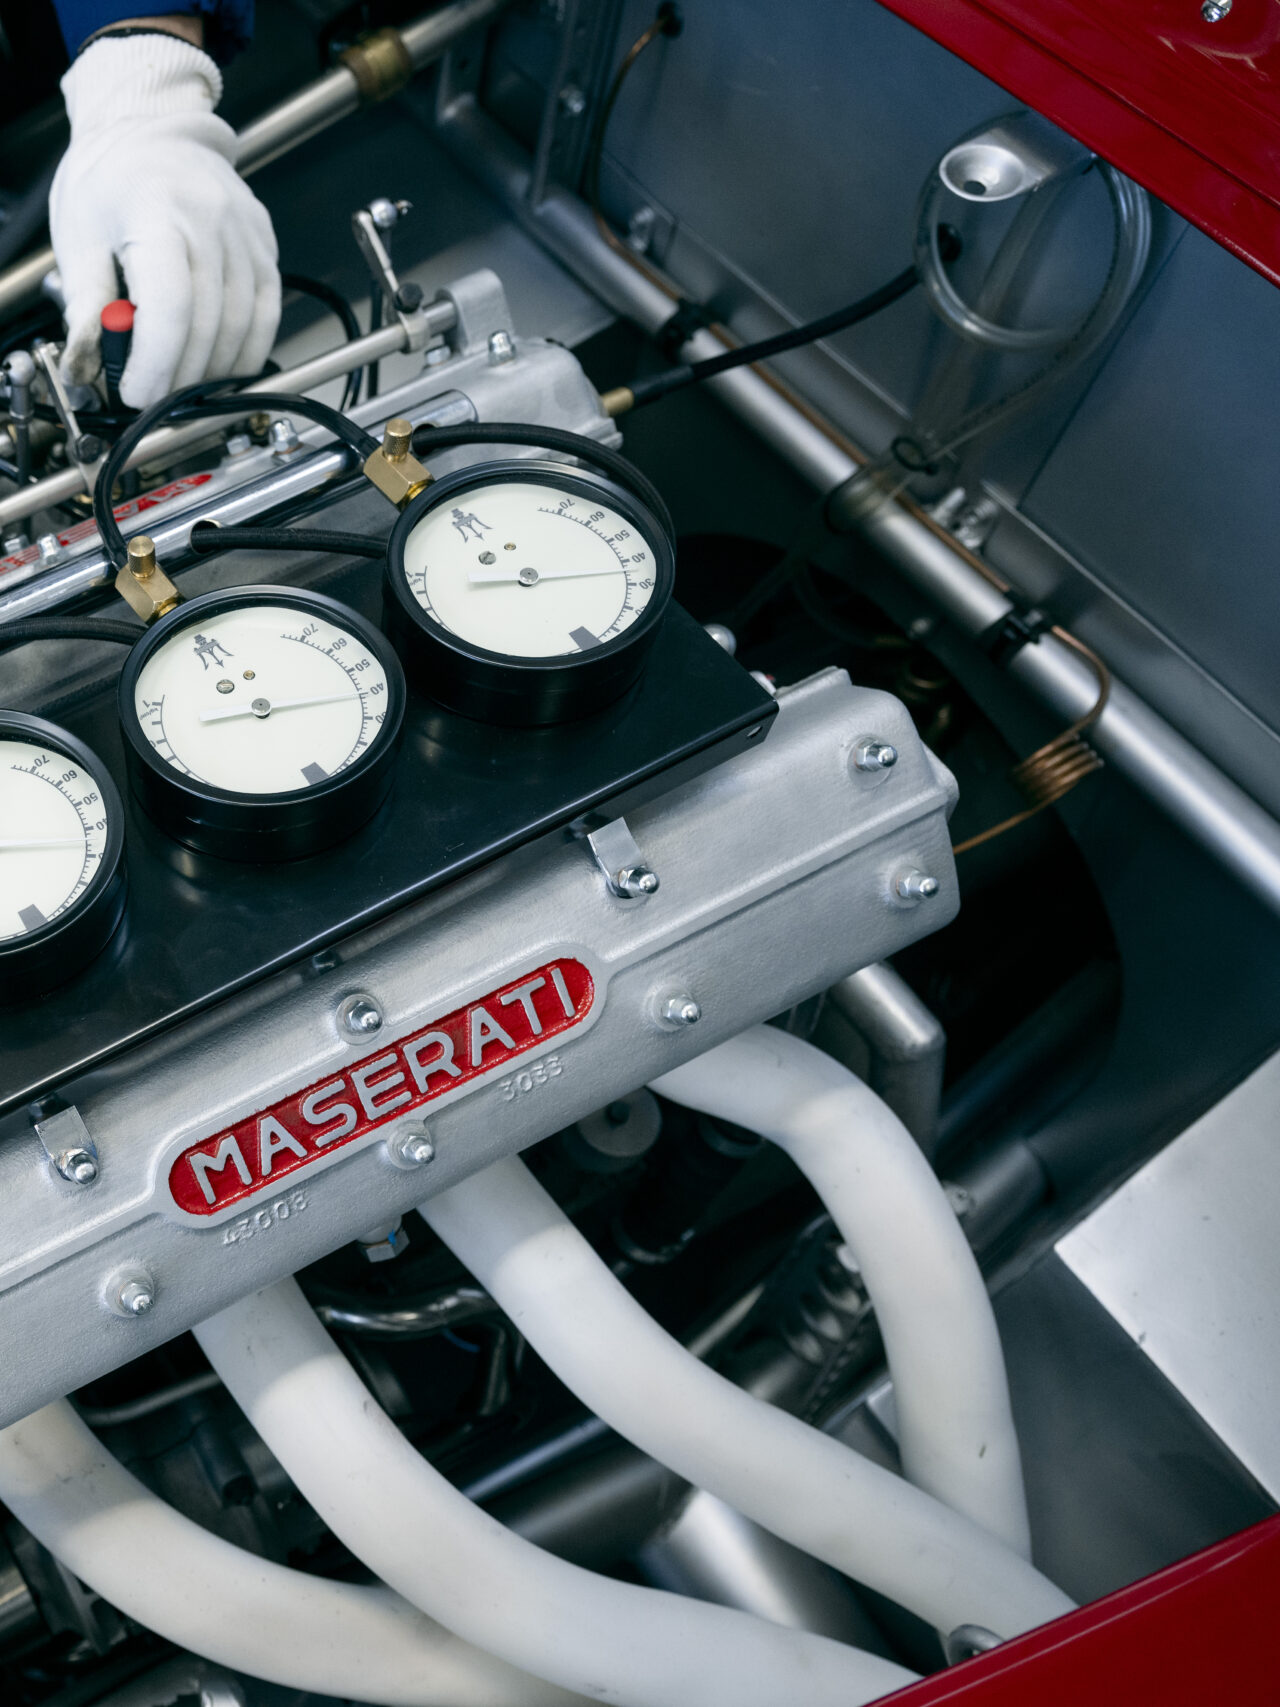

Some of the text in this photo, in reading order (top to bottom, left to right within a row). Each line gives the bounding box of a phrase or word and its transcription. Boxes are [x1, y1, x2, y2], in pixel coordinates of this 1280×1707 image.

[559, 499, 575, 511] 70
[589, 510, 606, 523] 60
[614, 529, 631, 542] 50
[631, 552, 646, 564] 40
[639, 578, 655, 590] 30
[302, 623, 319, 637] 70
[332, 637, 348, 651] 60
[355, 658, 371, 672] 50
[370, 682, 384, 696] 40
[34, 754, 51, 768] 70
[62, 769, 78, 783] 60
[83, 792, 99, 806] 50
[187, 967, 576, 1205] MASERATI
